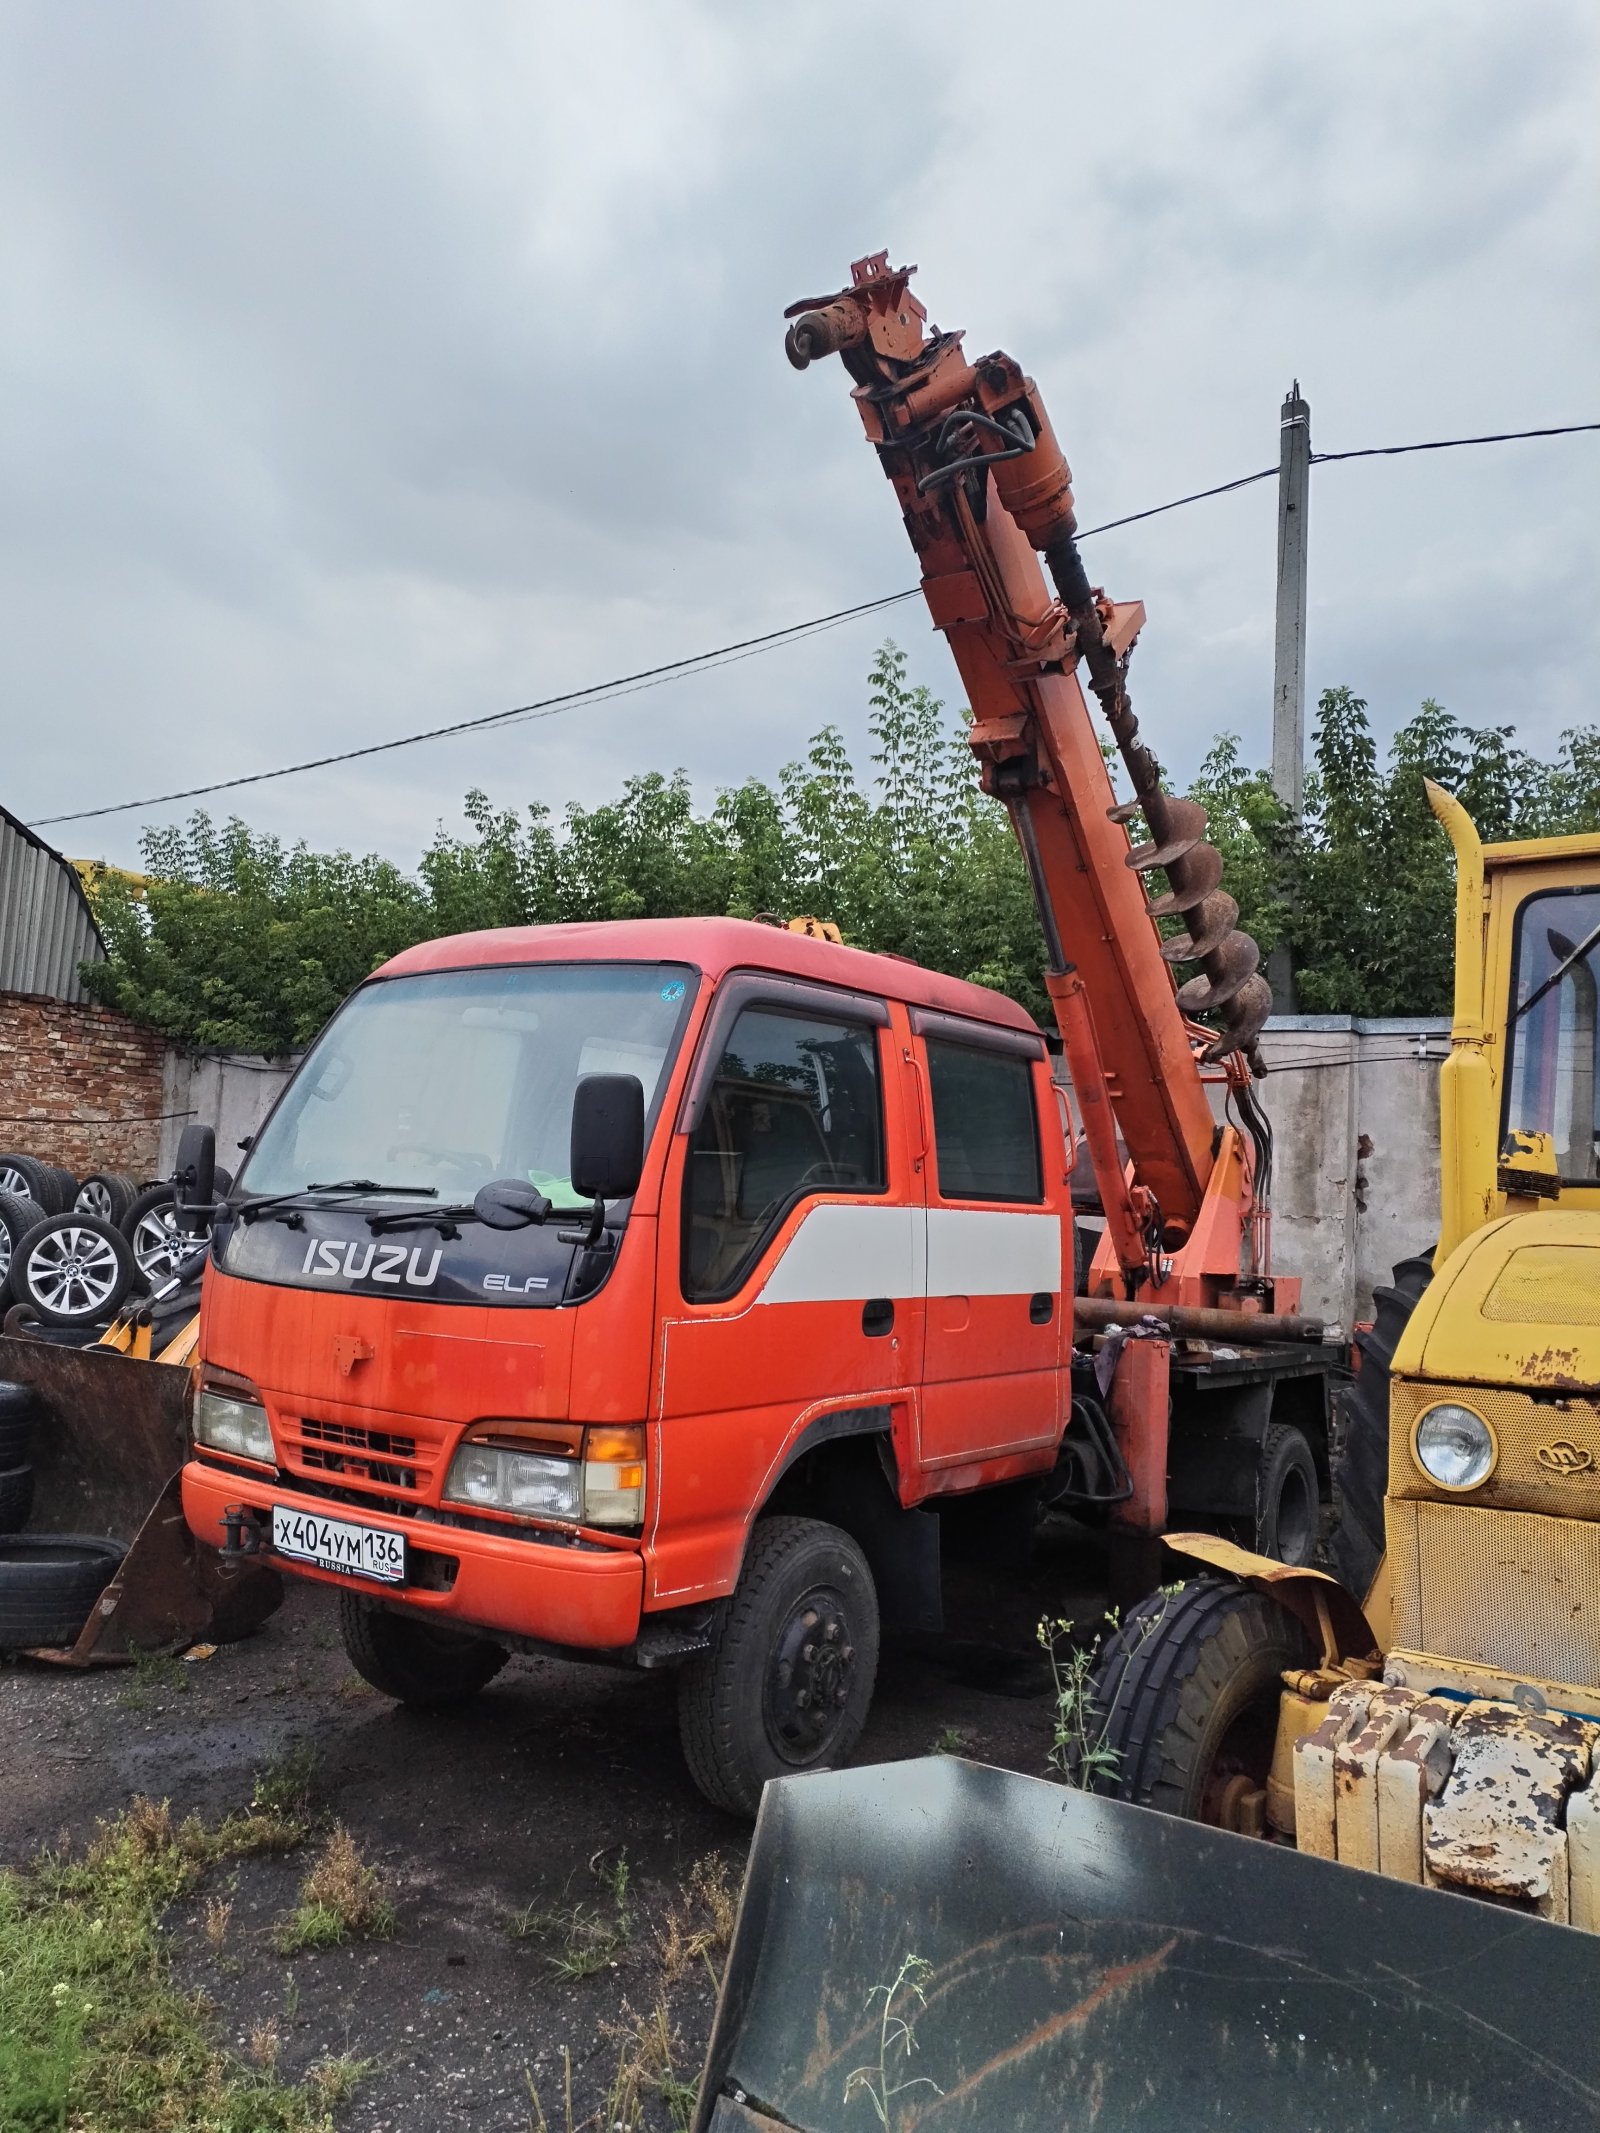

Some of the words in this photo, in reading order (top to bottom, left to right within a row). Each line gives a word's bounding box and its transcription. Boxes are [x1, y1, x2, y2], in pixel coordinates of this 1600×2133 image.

[302, 1239, 443, 1286] ISUZU
[483, 1274, 549, 1293] ELF
[364, 1532, 399, 1563] 136
[319, 1559, 351, 1575] RUSSIA
[372, 1560, 390, 1572] RUS
